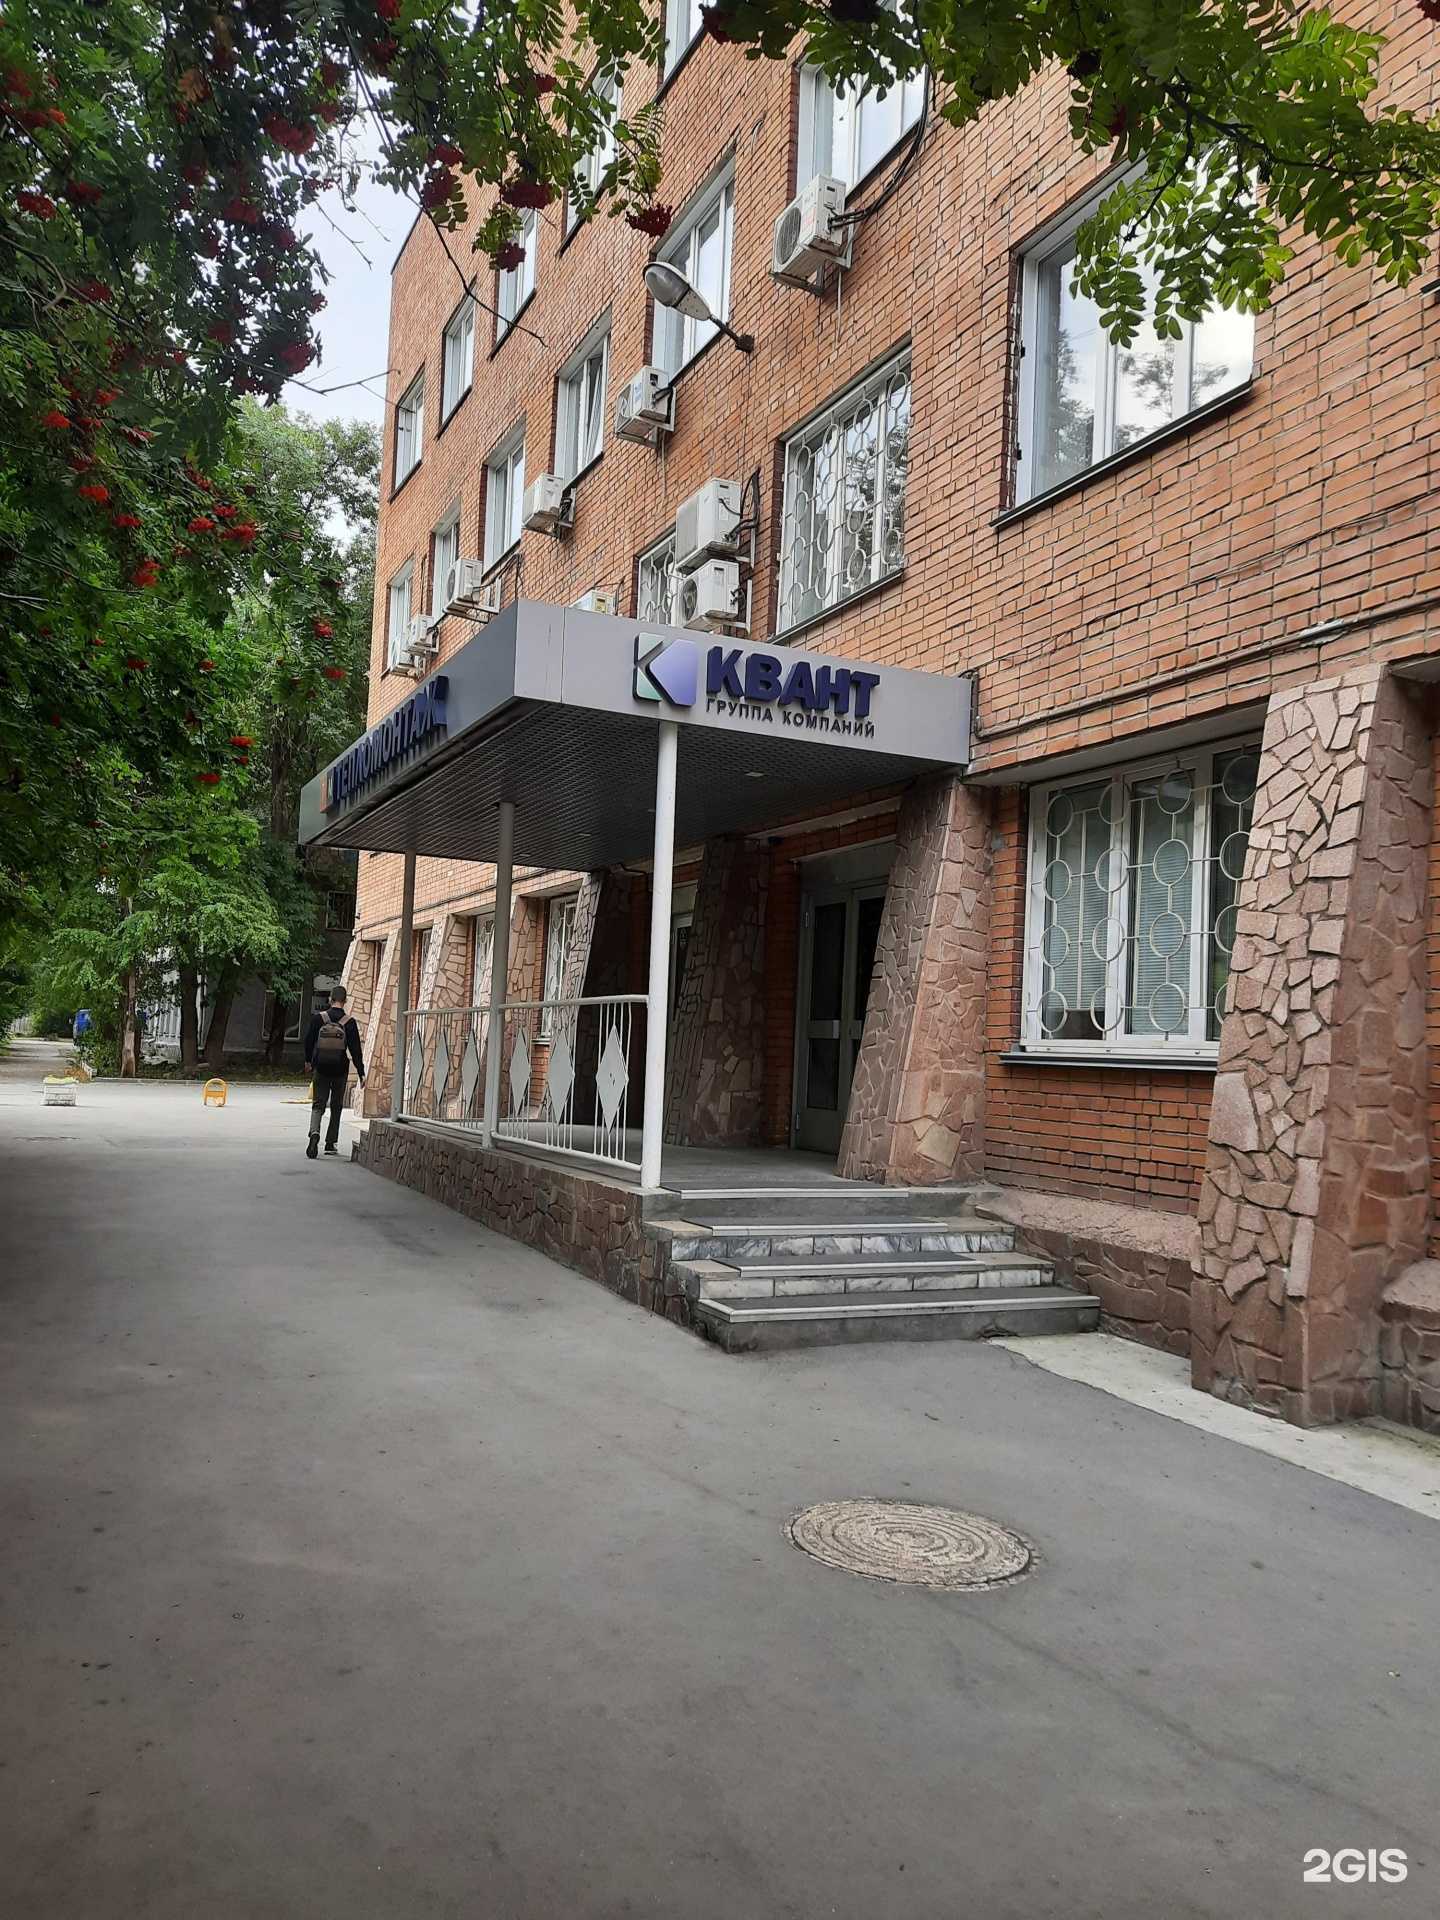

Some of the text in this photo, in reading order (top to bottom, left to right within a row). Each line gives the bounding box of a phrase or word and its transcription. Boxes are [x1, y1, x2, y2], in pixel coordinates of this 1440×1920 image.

[706, 646, 881, 719] КВАНТ
[705, 699, 876, 738] ГРУППА КОМПАНИЙ
